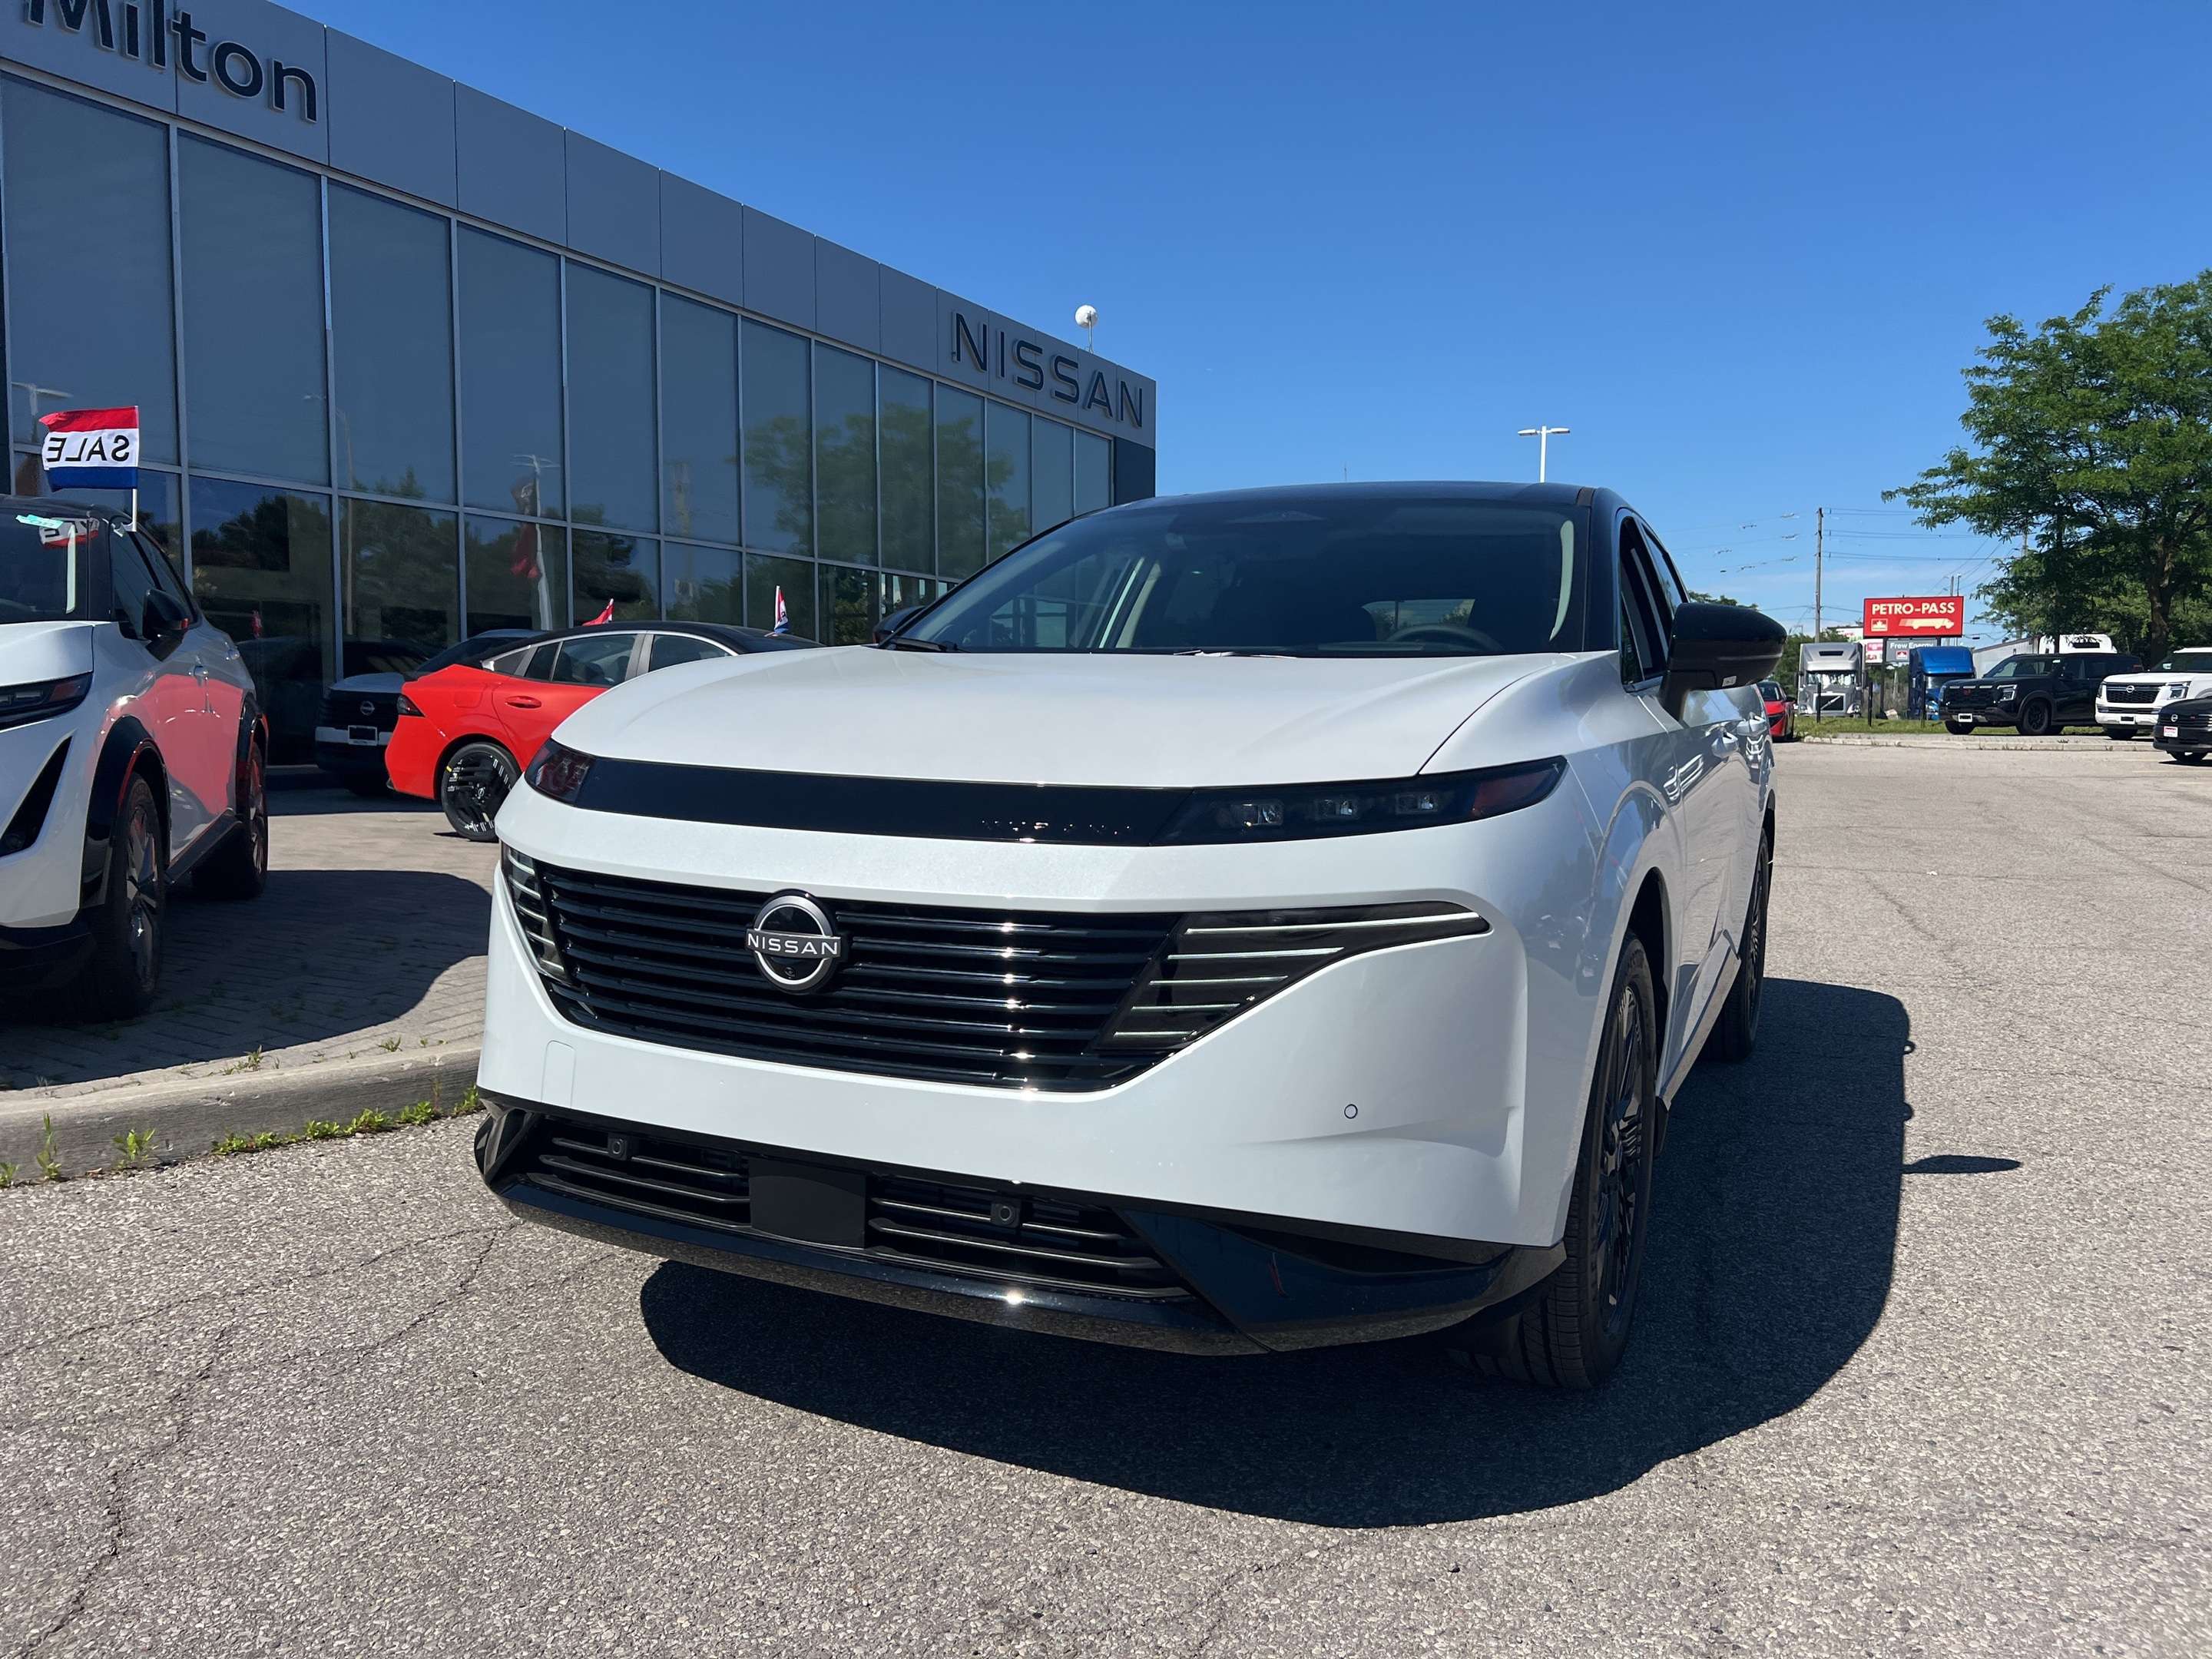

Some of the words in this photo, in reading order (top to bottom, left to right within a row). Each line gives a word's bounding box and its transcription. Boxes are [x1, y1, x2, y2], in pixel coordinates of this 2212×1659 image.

[28, 0, 317, 123] Milton
[953, 311, 1143, 428] NISSAN
[1872, 602, 1955, 615] PETRO-PASS
[747, 933, 838, 955] NISSAN
